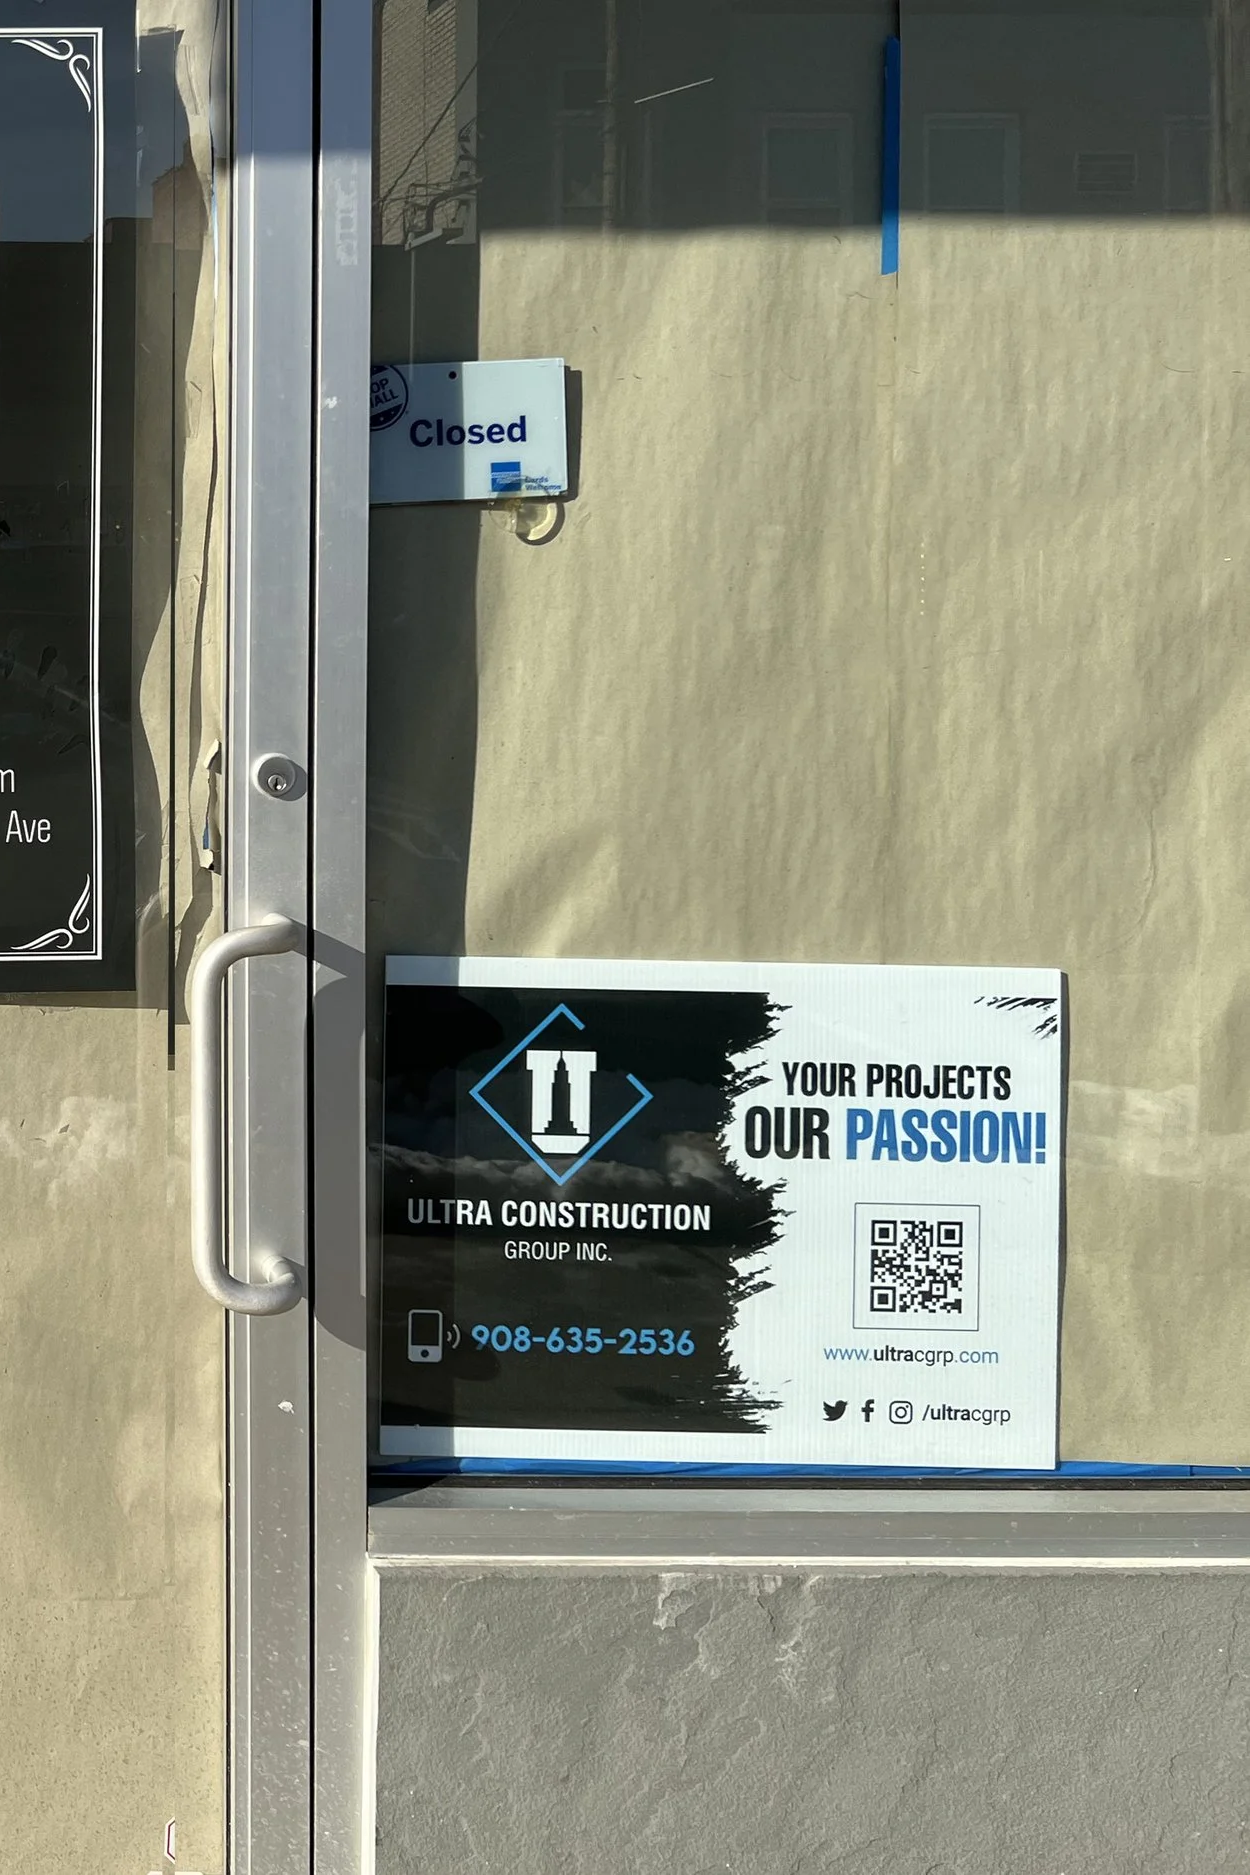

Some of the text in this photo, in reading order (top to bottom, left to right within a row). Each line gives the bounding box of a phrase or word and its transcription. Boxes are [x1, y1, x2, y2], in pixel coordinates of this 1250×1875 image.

[409, 415, 527, 447] Closed
[5, 810, 51, 843] Ave
[781, 1061, 1011, 1101] YOUR PROJECTS
[744, 1105, 1047, 1165] OUR PASSION!
[408, 1198, 711, 1231] ULTRA CONSTRUCTION
[504, 1240, 613, 1262] GROUP INC.
[471, 1324, 695, 1356] 908-635-2536
[823, 1344, 999, 1367] www.ultracgrp.com
[921, 1403, 1011, 1426] /ultracgrp
